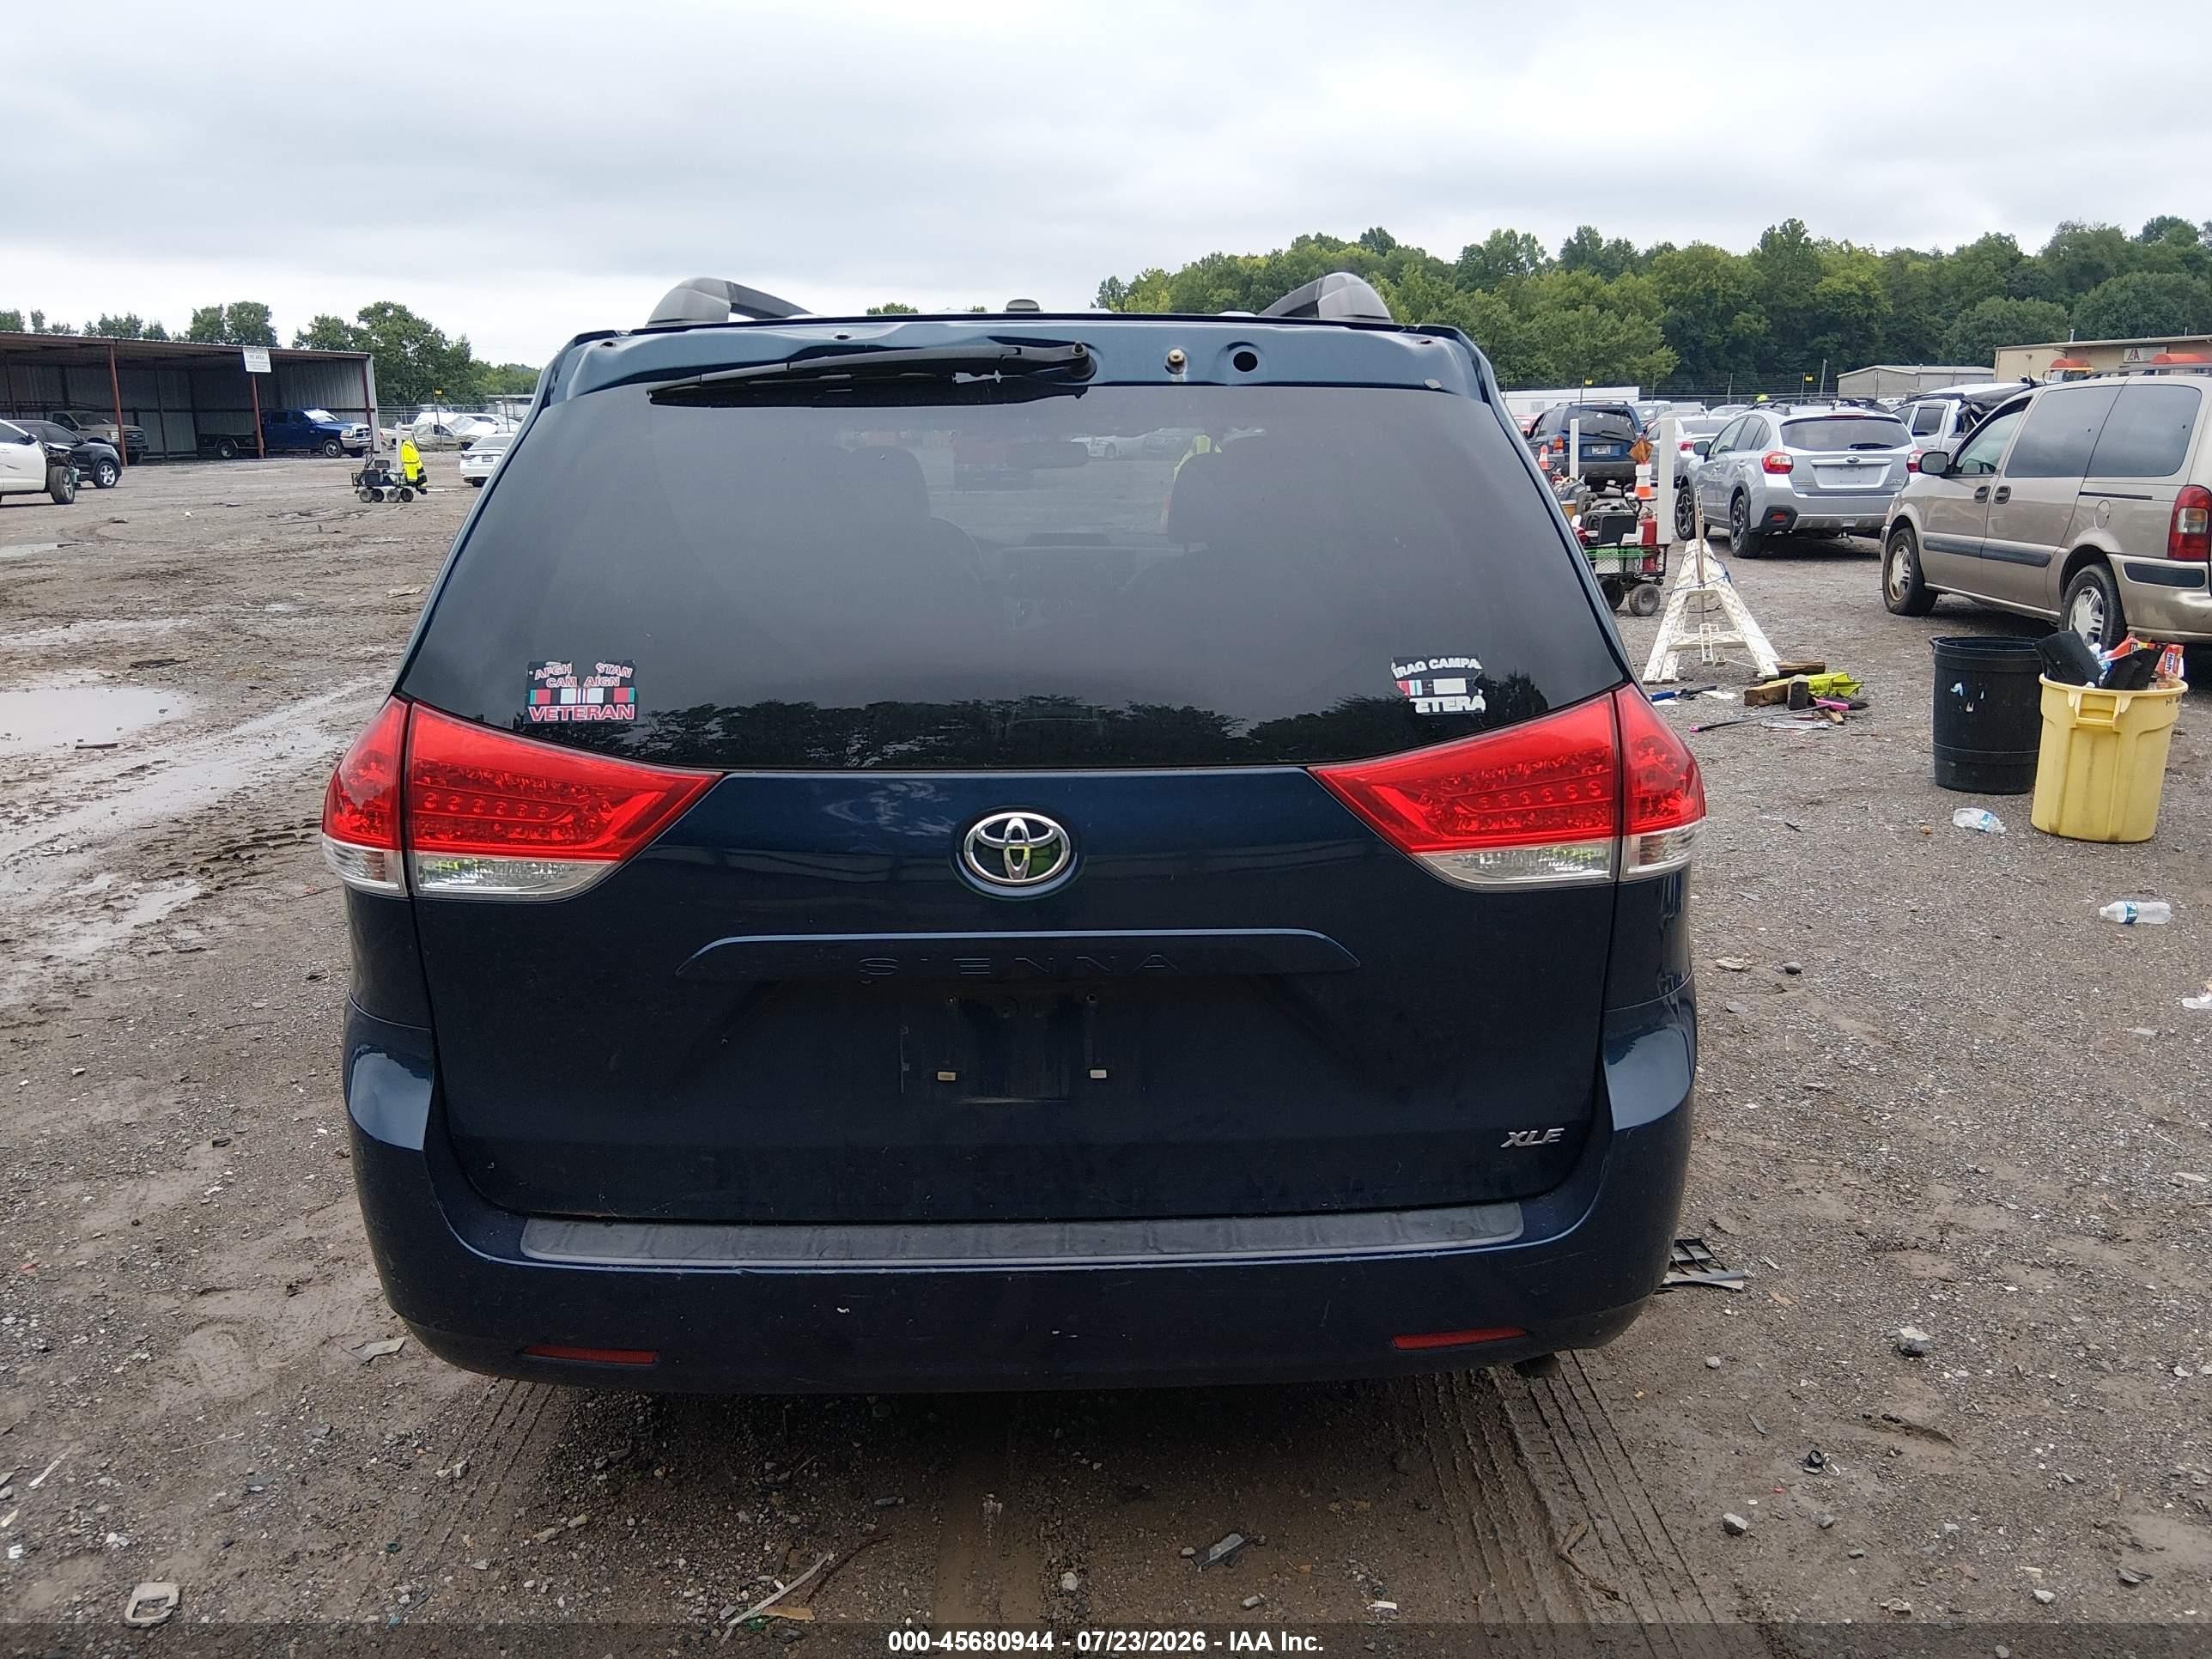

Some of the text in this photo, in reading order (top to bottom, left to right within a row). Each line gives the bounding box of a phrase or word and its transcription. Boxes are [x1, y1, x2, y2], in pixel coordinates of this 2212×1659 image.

[528, 704, 635, 722] VETERAN
[1409, 696, 1486, 714] ETERA
[1499, 1127, 1565, 1148] XLE
